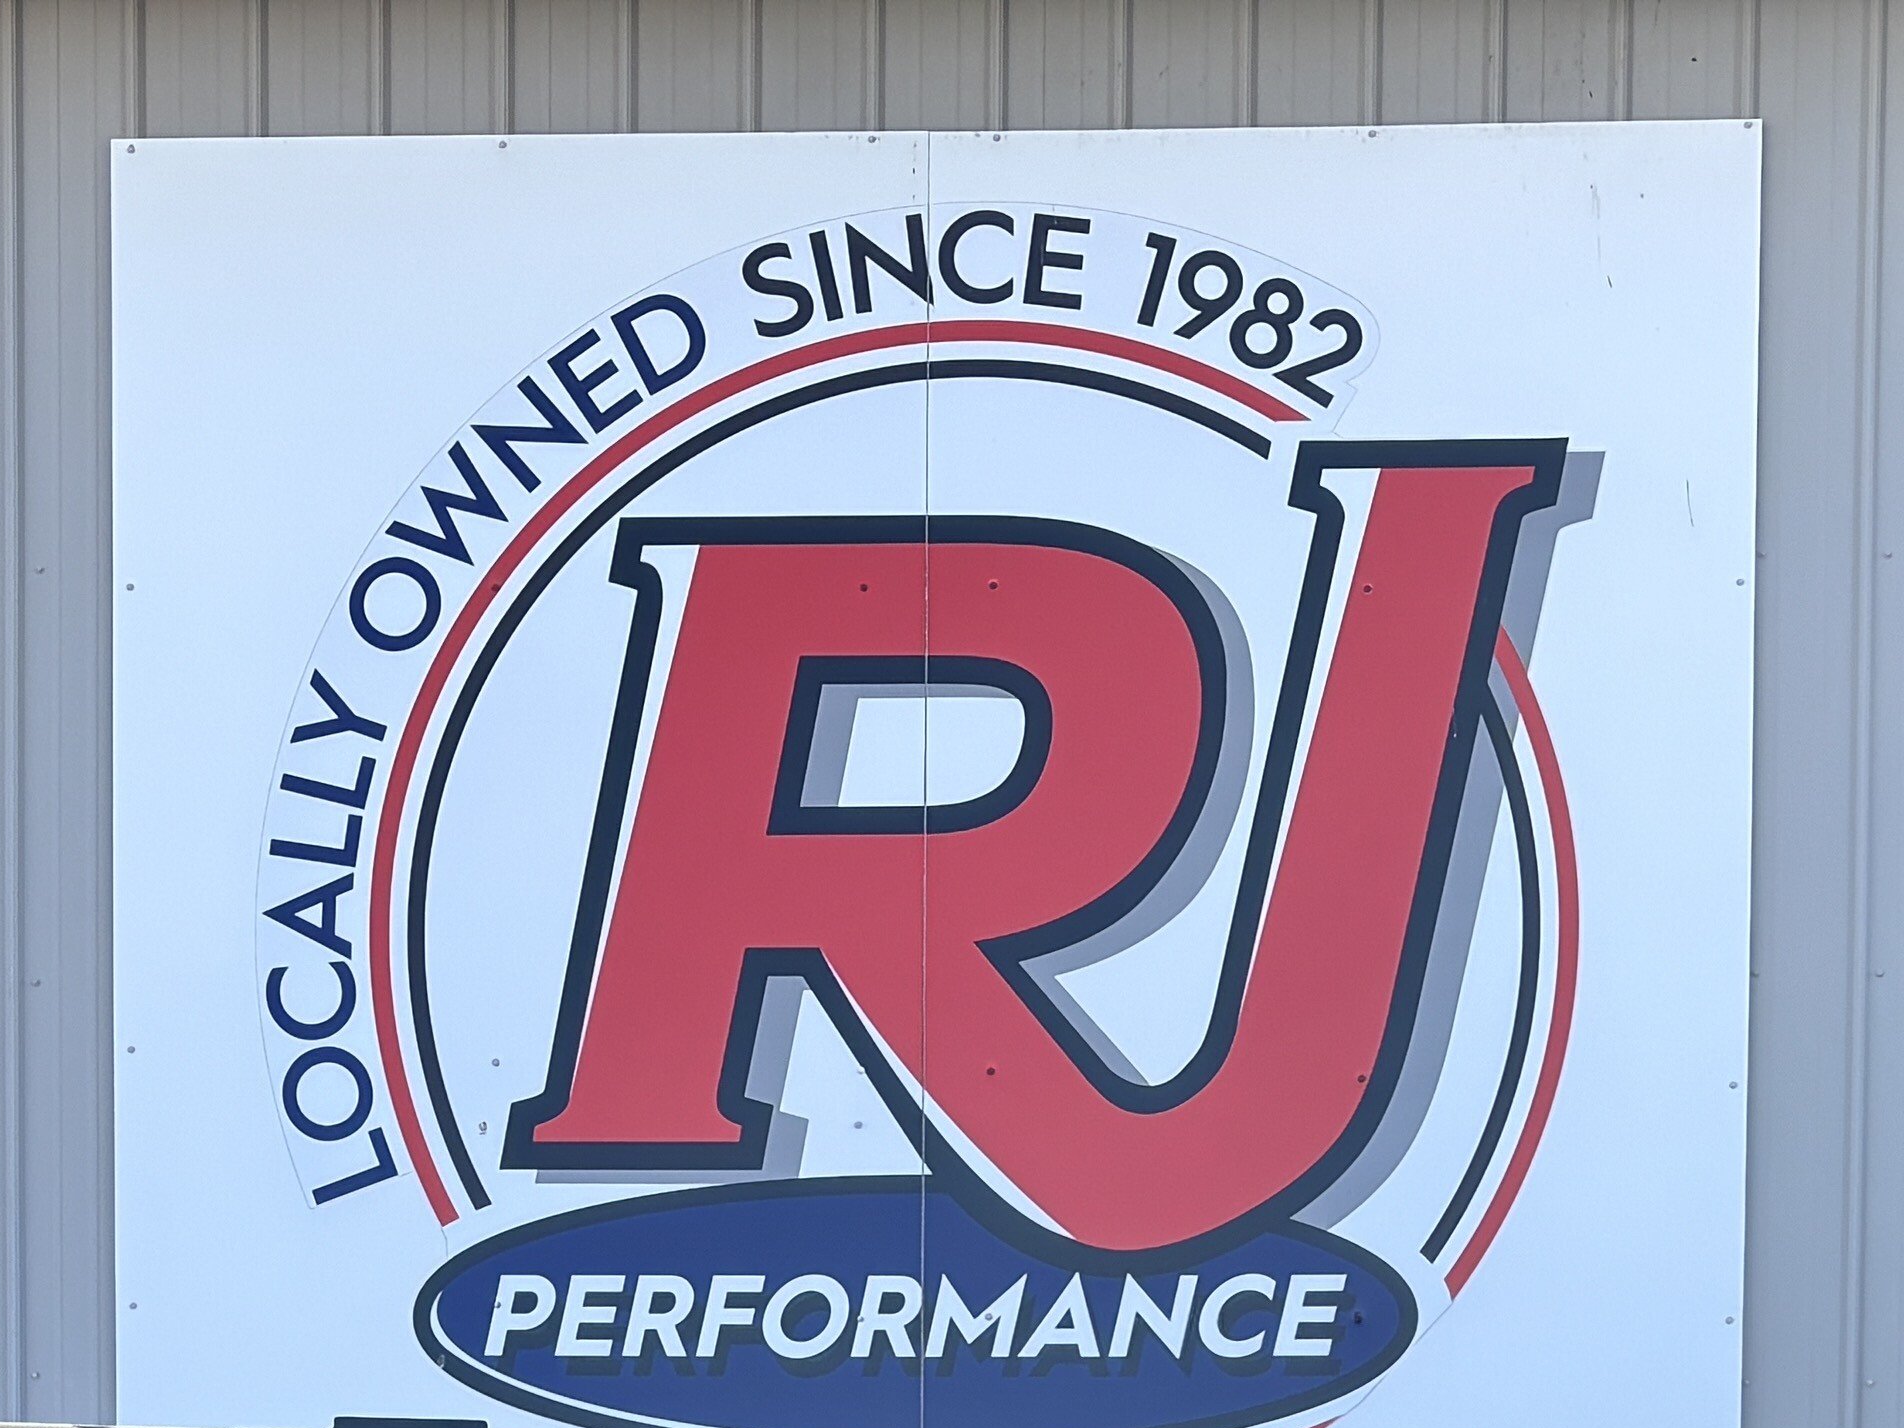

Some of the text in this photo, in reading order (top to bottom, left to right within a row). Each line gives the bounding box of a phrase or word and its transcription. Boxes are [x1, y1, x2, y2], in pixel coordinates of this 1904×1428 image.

[262, 209, 1363, 1206] LOCALLY OWNED SINCE 1982
[502, 437, 1570, 1270] RJ
[483, 1271, 1348, 1359] PERFORMANCE
